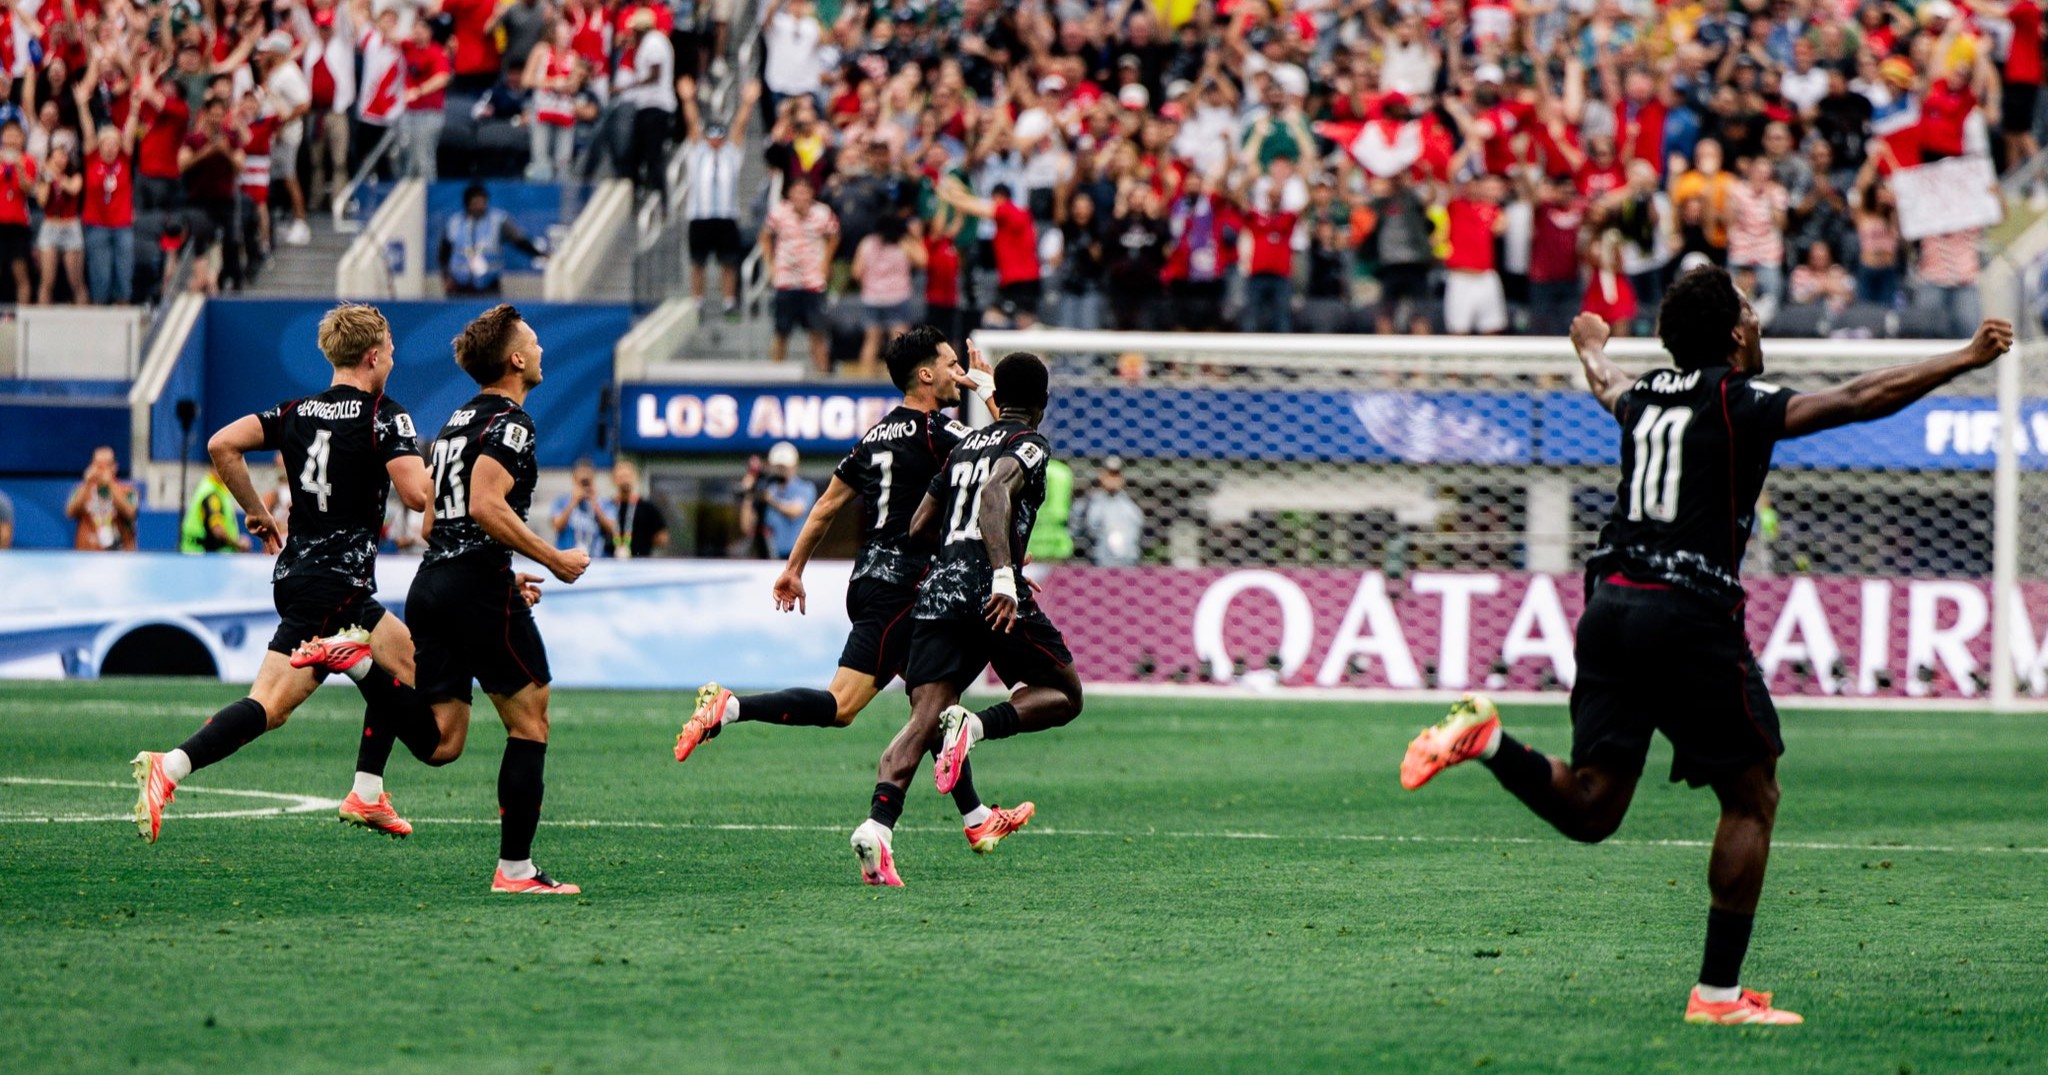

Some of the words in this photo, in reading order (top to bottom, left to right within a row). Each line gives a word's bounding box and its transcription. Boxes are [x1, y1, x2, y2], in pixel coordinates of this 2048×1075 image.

[636, 393, 738, 438] LOS
[747, 394, 906, 440] ANGE
[299, 429, 332, 512] 4
[433, 436, 468, 519] 23
[871, 451, 893, 529] 7
[944, 456, 991, 546] 22
[1627, 404, 1693, 523] 10
[1193, 568, 1576, 690] QATA
